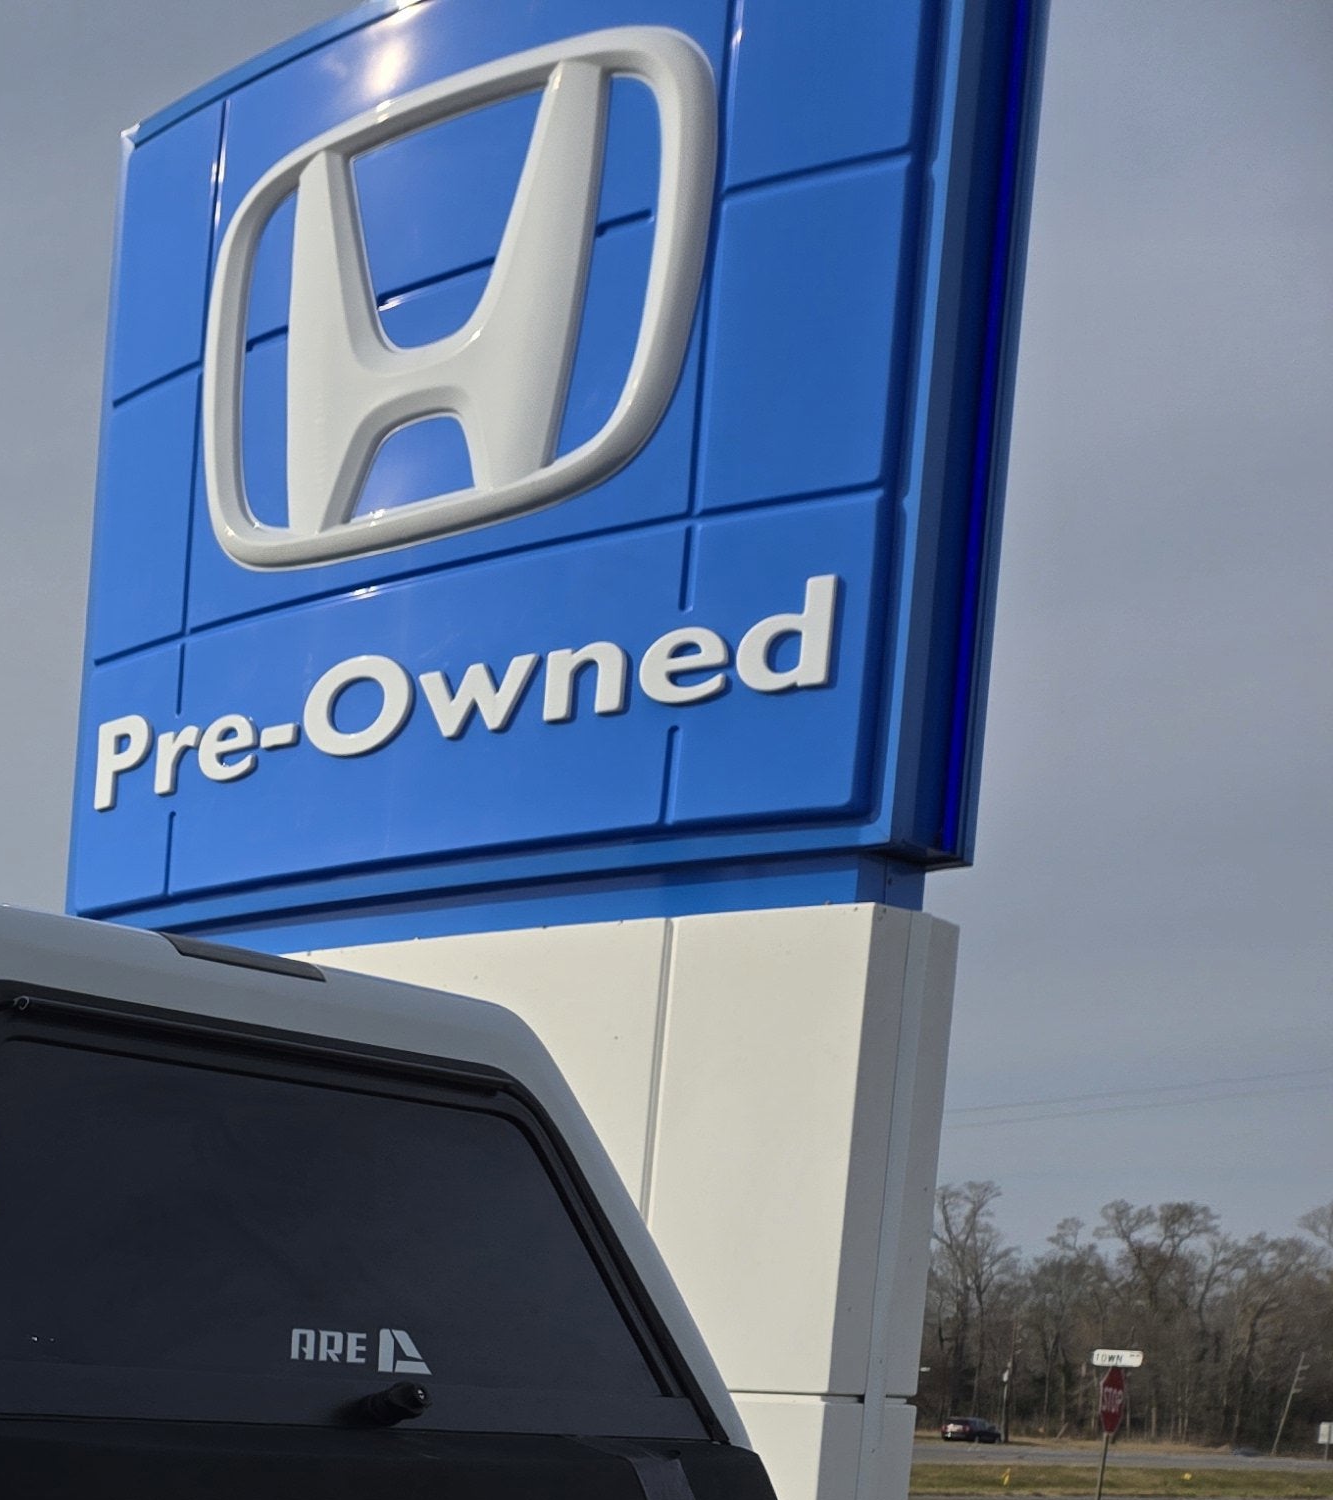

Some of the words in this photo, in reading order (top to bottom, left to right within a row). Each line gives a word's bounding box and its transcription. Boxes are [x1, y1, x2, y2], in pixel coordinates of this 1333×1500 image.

[94, 573, 839, 811] Pre-Owned
[290, 1328, 367, 1364] ARE
[1103, 1387, 1123, 1413] STOP
